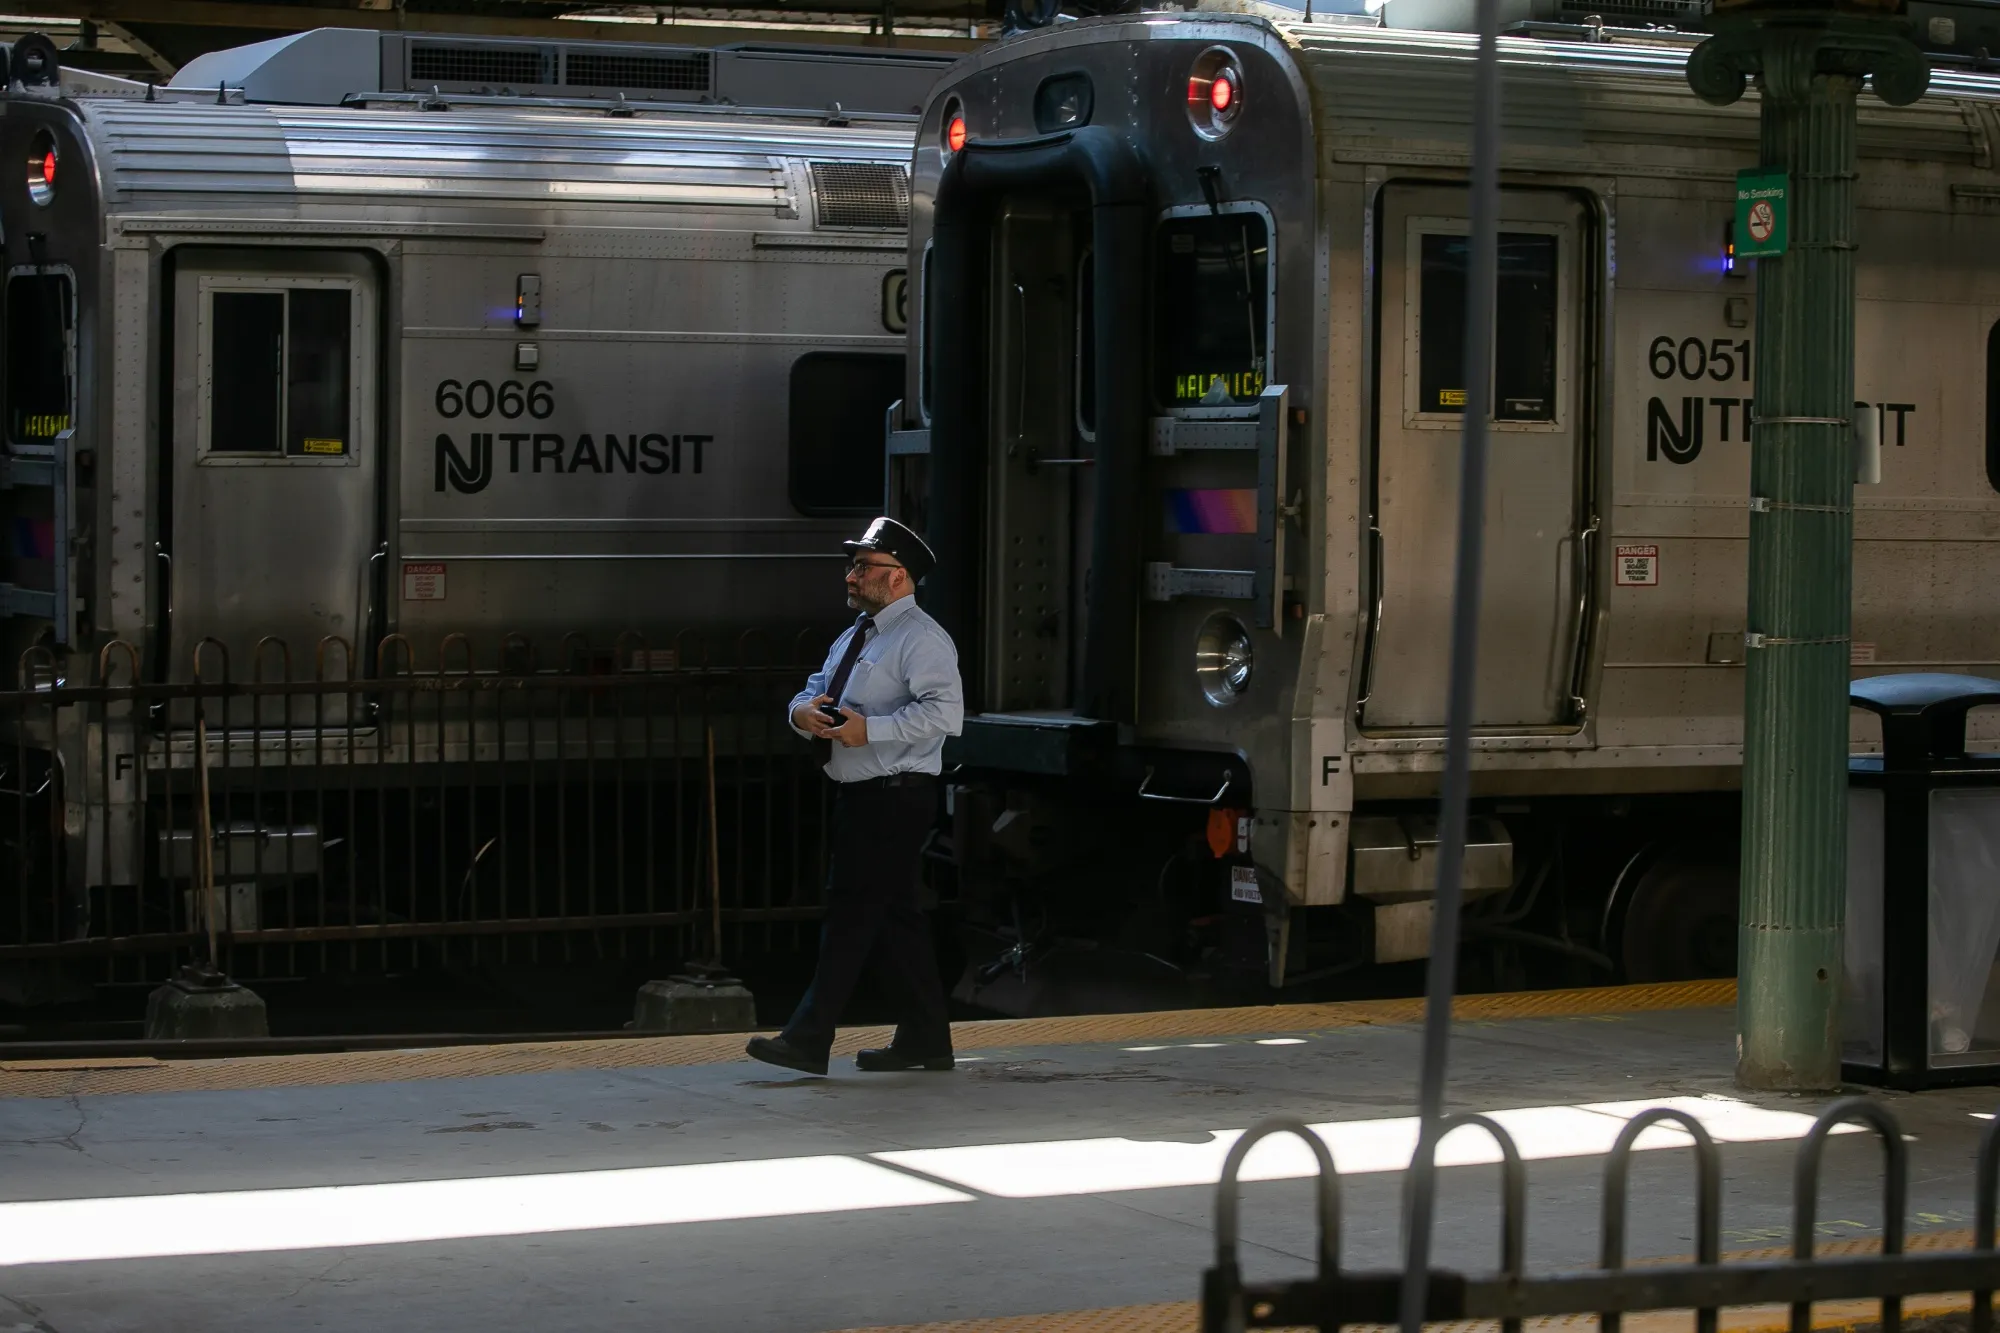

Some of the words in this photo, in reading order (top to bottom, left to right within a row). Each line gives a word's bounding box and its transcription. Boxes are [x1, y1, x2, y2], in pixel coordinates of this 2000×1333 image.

[1738, 190, 1750, 201] No
[1750, 188, 1784, 199] Smoking
[1649, 335, 1750, 382] 6051
[435, 379, 554, 419] 6066
[1647, 396, 1703, 465] NJ
[434, 433, 493, 494] NJ
[499, 433, 714, 474] TRANSIT
[1618, 546, 1656, 555] DANGER
[407, 565, 443, 573] DANGER
[115, 753, 134, 781] F
[1322, 755, 1342, 786] F
[1233, 867, 1258, 884] DANGE
